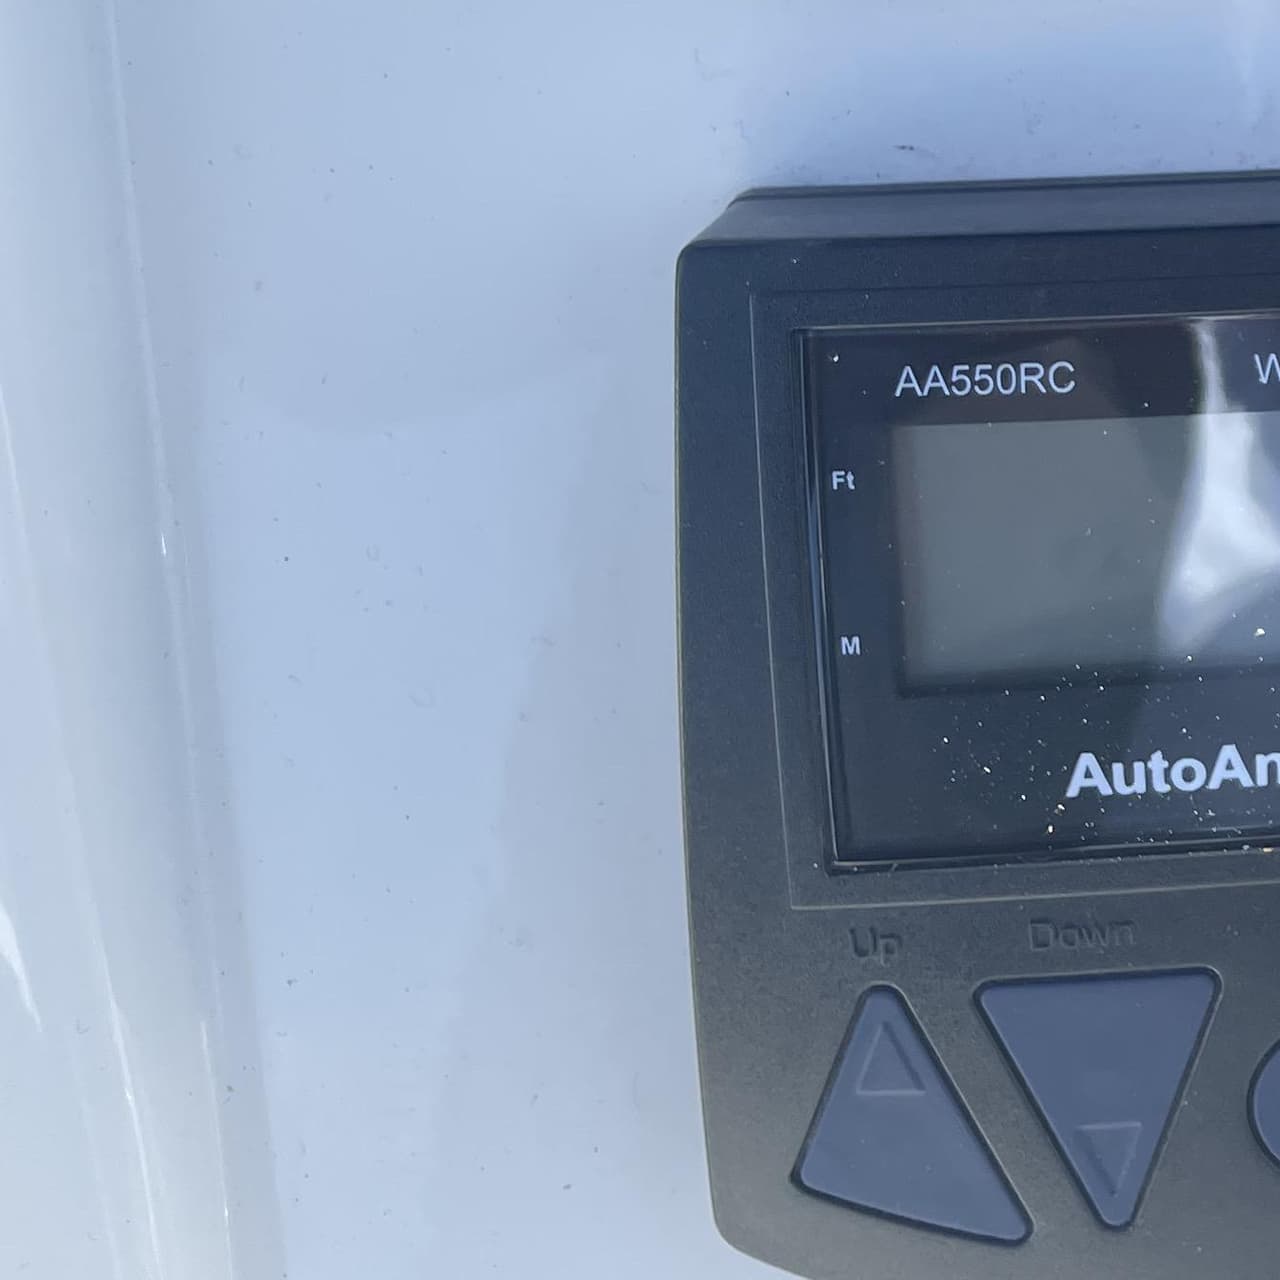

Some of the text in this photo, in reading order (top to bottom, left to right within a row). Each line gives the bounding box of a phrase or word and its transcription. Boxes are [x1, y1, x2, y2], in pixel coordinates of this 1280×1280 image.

[894, 361, 1077, 399] AA550RC
[831, 470, 856, 492] Ft
[839, 637, 861, 656] M
[848, 926, 902, 964] Up
[1028, 920, 1138, 954] Down
